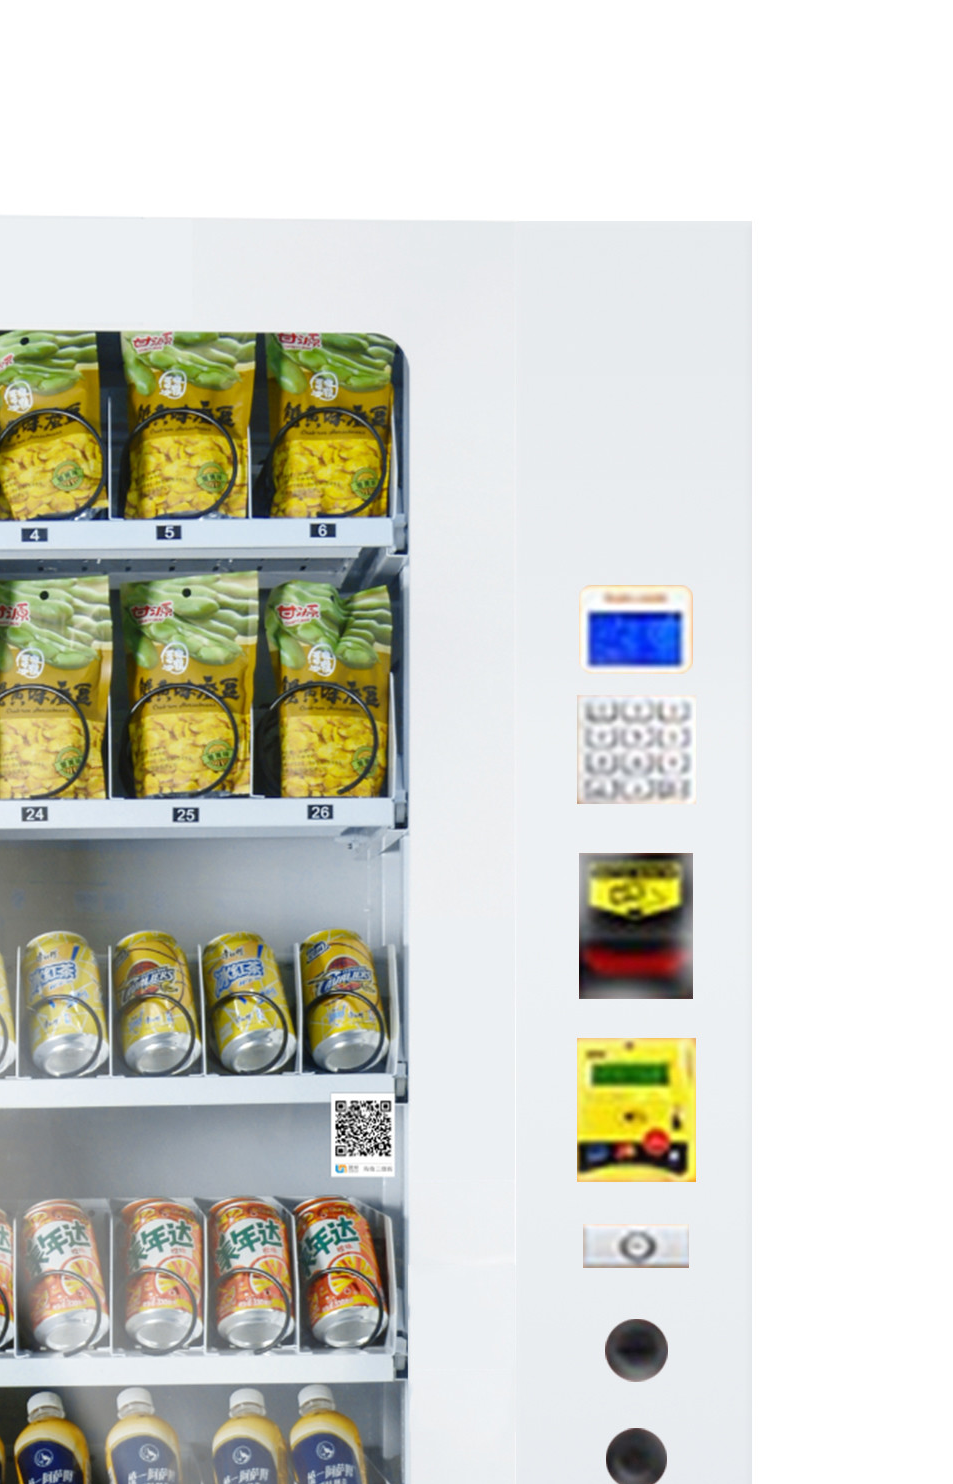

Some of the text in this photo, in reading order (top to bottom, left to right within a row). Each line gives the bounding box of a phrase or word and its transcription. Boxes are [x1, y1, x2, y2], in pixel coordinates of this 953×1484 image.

[26, 808, 45, 820] 24
[177, 808, 195, 821] 25
[311, 806, 330, 818] 26
[128, 1220, 194, 1272] 美年达
[216, 1219, 283, 1270] 美年达
